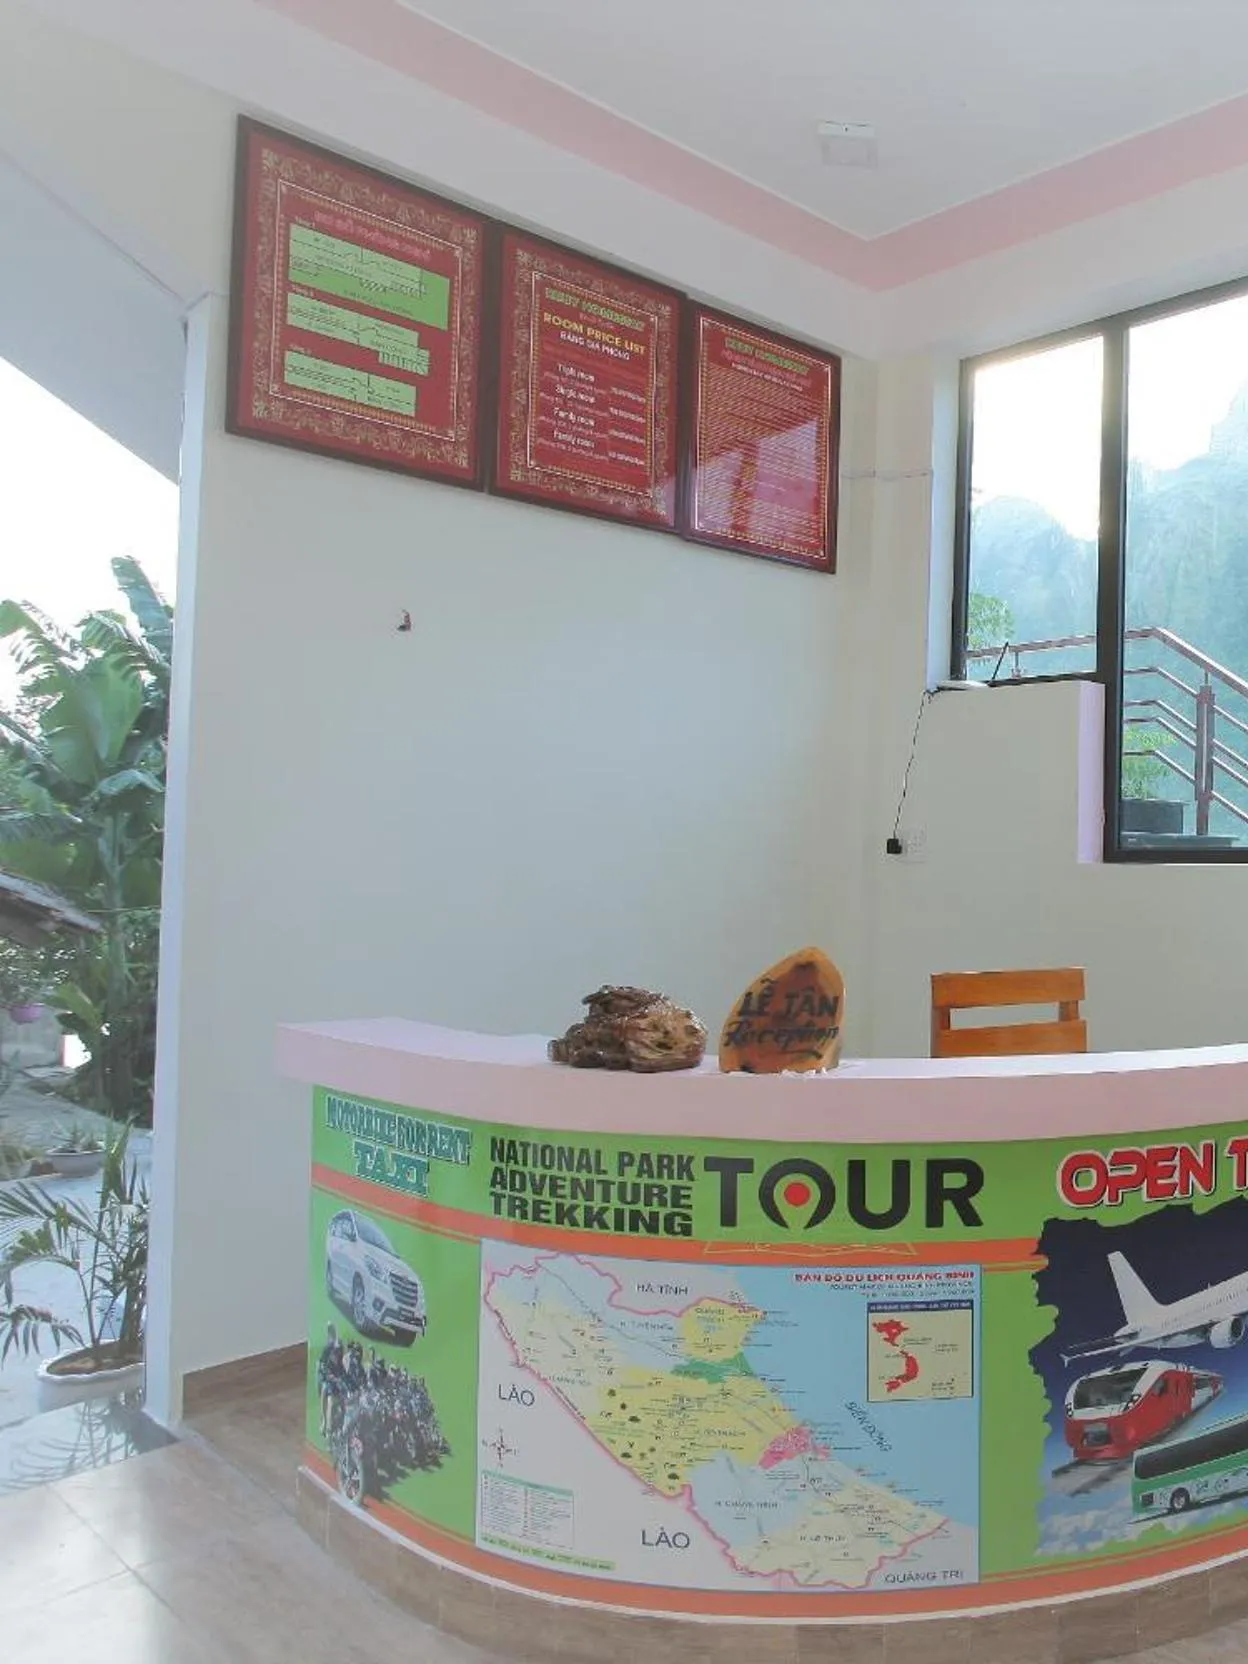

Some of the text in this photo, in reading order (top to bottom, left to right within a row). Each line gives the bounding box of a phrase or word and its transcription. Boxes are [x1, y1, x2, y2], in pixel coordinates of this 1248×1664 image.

[543, 312, 584, 334] ROOM
[587, 327, 622, 347] PRICE
[624, 341, 646, 355] LIST
[490, 1135, 696, 1181] NATIONAL PARK
[1057, 1140, 1217, 1208] OPEN
[490, 1166, 693, 1210] ADVENTURE
[703, 1156, 985, 1230] TOUR
[489, 1191, 693, 1237] TREKKING
